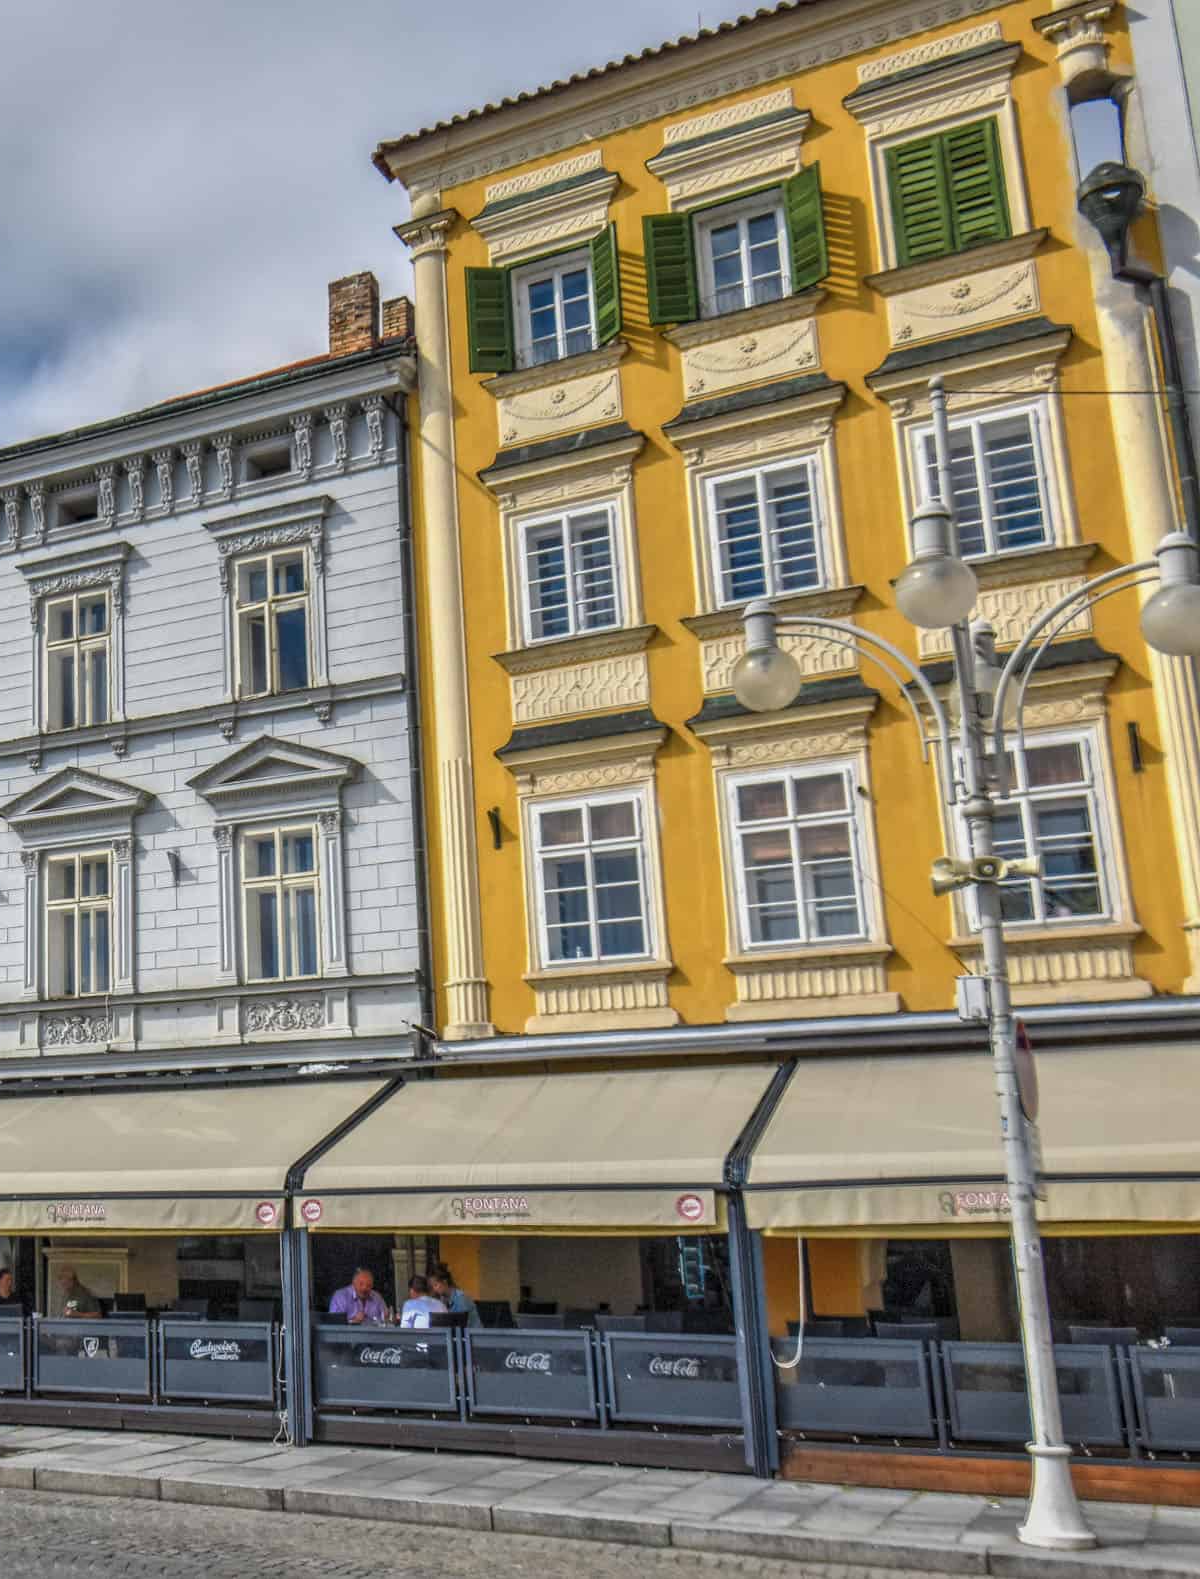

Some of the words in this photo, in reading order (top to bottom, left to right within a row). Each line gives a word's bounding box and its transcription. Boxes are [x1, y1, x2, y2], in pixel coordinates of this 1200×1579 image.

[464, 1197, 528, 1209] FONTANA
[954, 1191, 1009, 1208] FONTA
[56, 1203, 105, 1216] FONTANA
[190, 1339, 240, 1357] Budweiser
